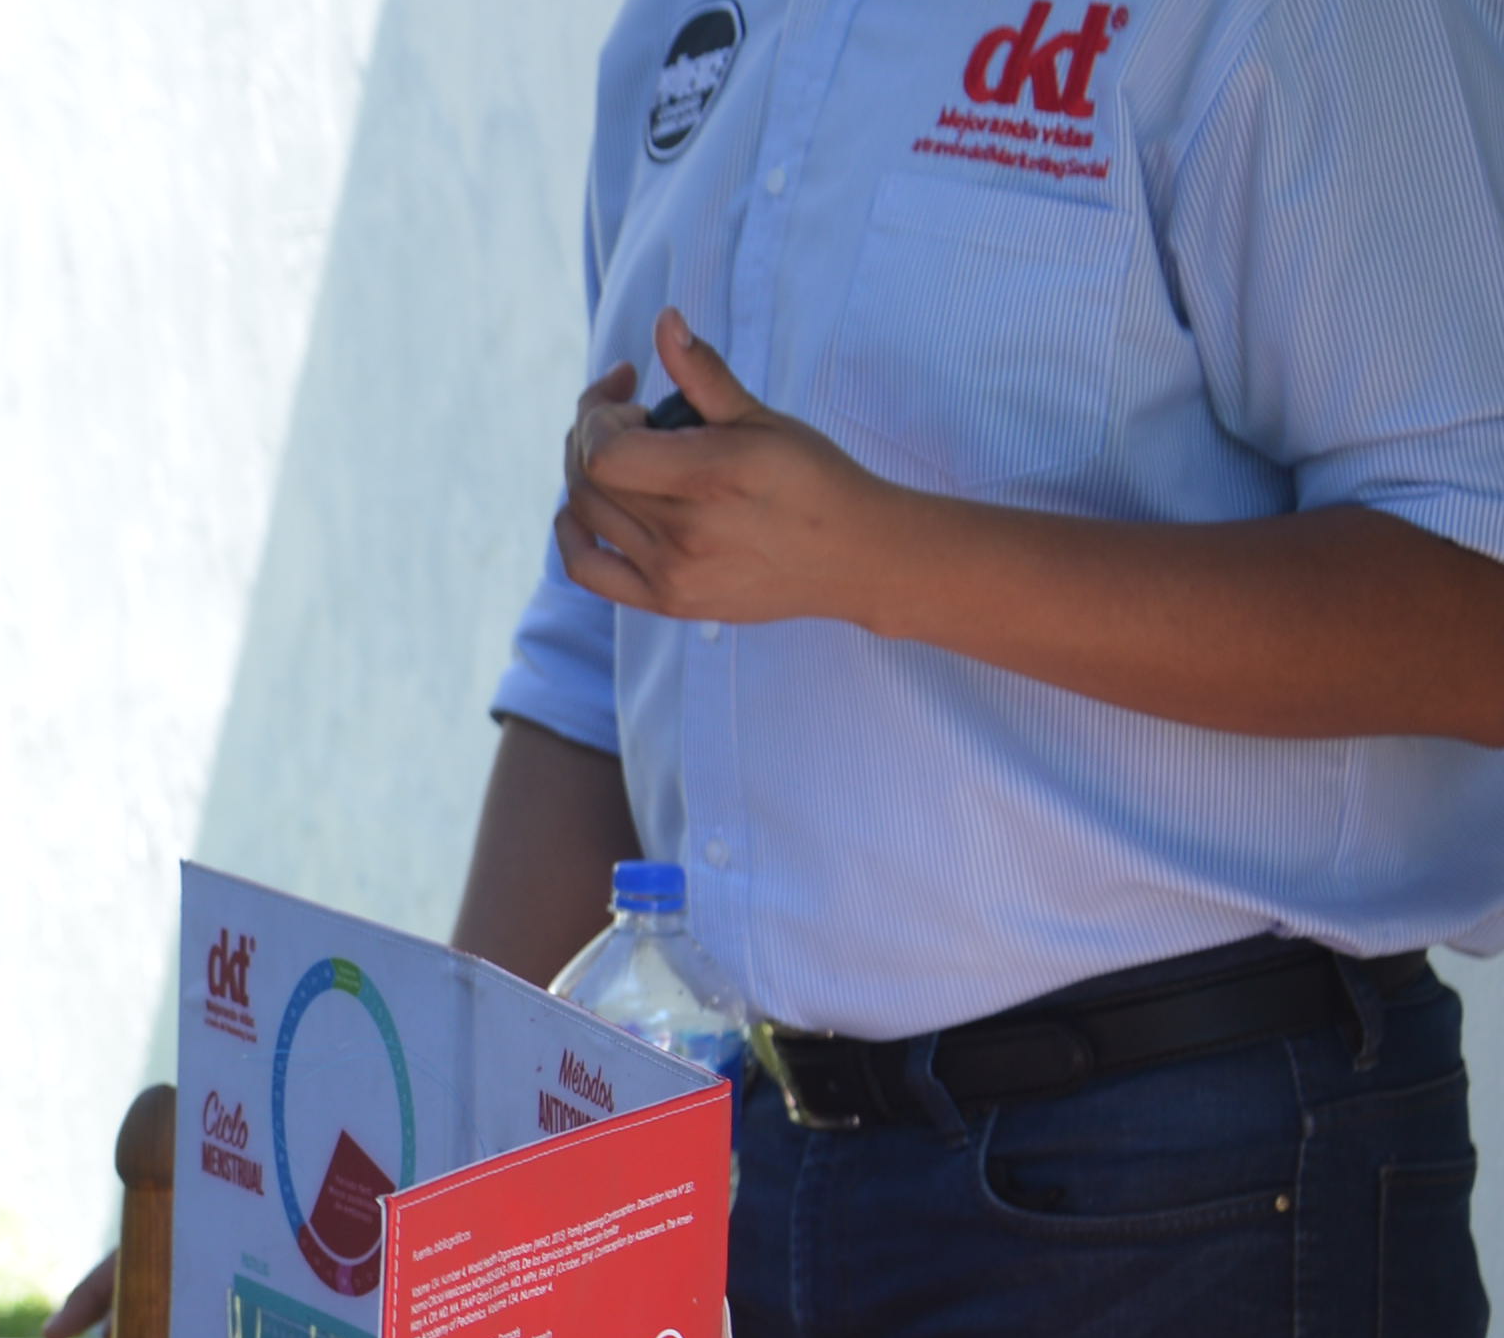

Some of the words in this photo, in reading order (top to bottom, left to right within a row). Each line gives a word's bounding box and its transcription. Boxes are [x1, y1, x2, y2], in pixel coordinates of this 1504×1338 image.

[1042, 123, 1094, 148] vidas
[559, 1047, 614, 1113] Métodos
[202, 1090, 248, 1150] Ciclo
[201, 1141, 264, 1197] MENSTRUAL
